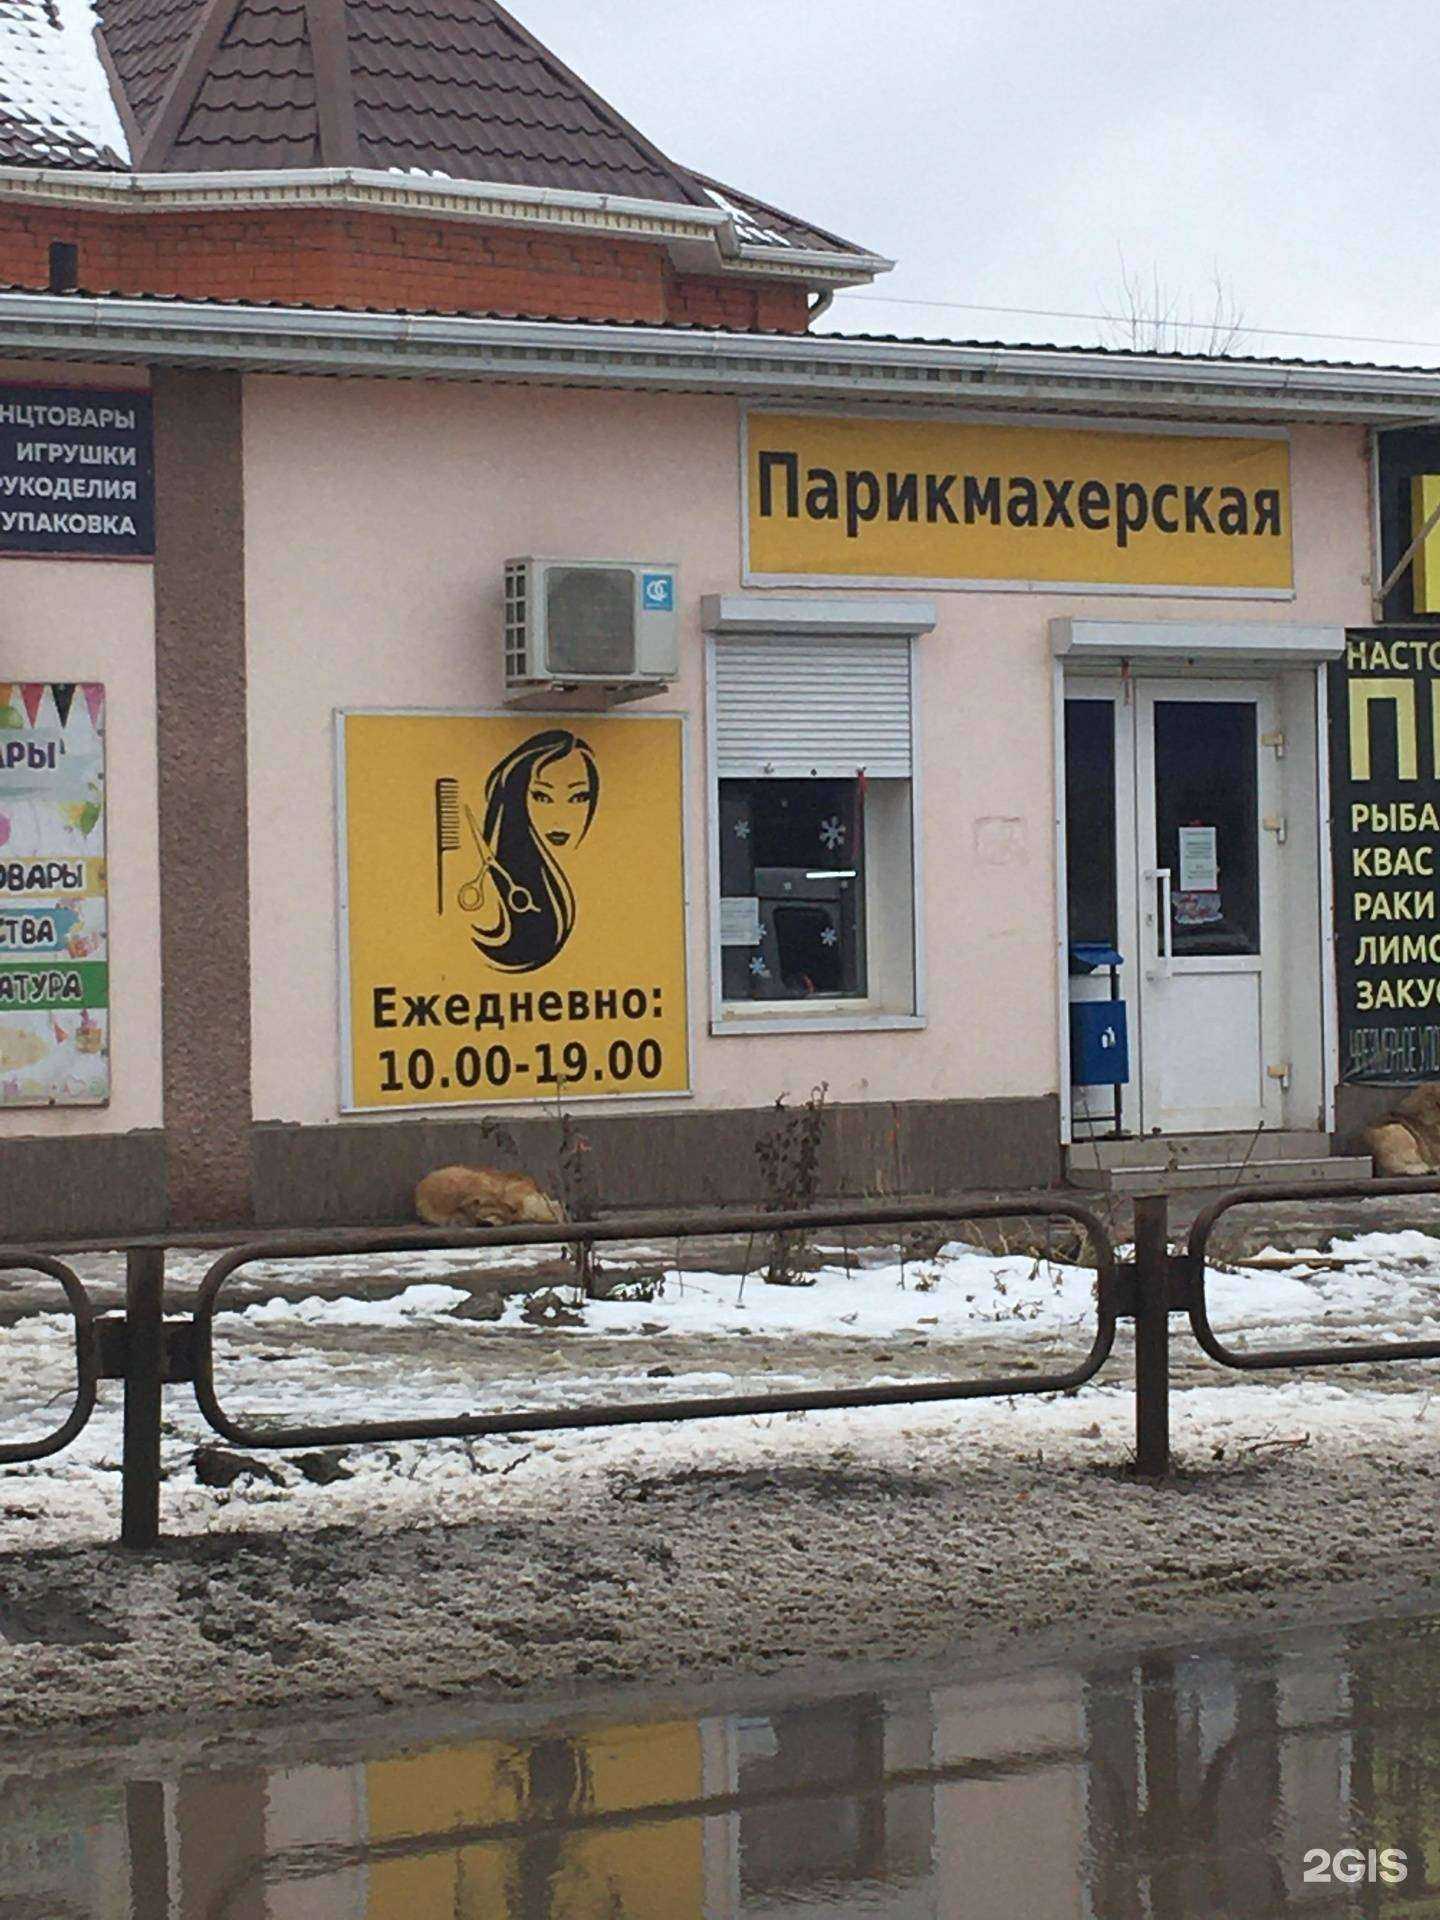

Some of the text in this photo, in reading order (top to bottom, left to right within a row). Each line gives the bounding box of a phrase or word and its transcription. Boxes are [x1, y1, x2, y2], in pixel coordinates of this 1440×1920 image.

[16, 442, 136, 466] ИГРУШКИ
[758, 450, 1282, 548] Парикмахерская
[2, 512, 136, 536] УПАКОВКА
[1351, 803, 1440, 832] РЫБА
[1353, 847, 1434, 877] КВАС
[1354, 890, 1434, 921] РАКИ
[373, 987, 661, 1031] Ежедневно:
[1356, 978, 1440, 1010] ЗАКУ
[379, 1038, 662, 1091] 10.00-19.00
